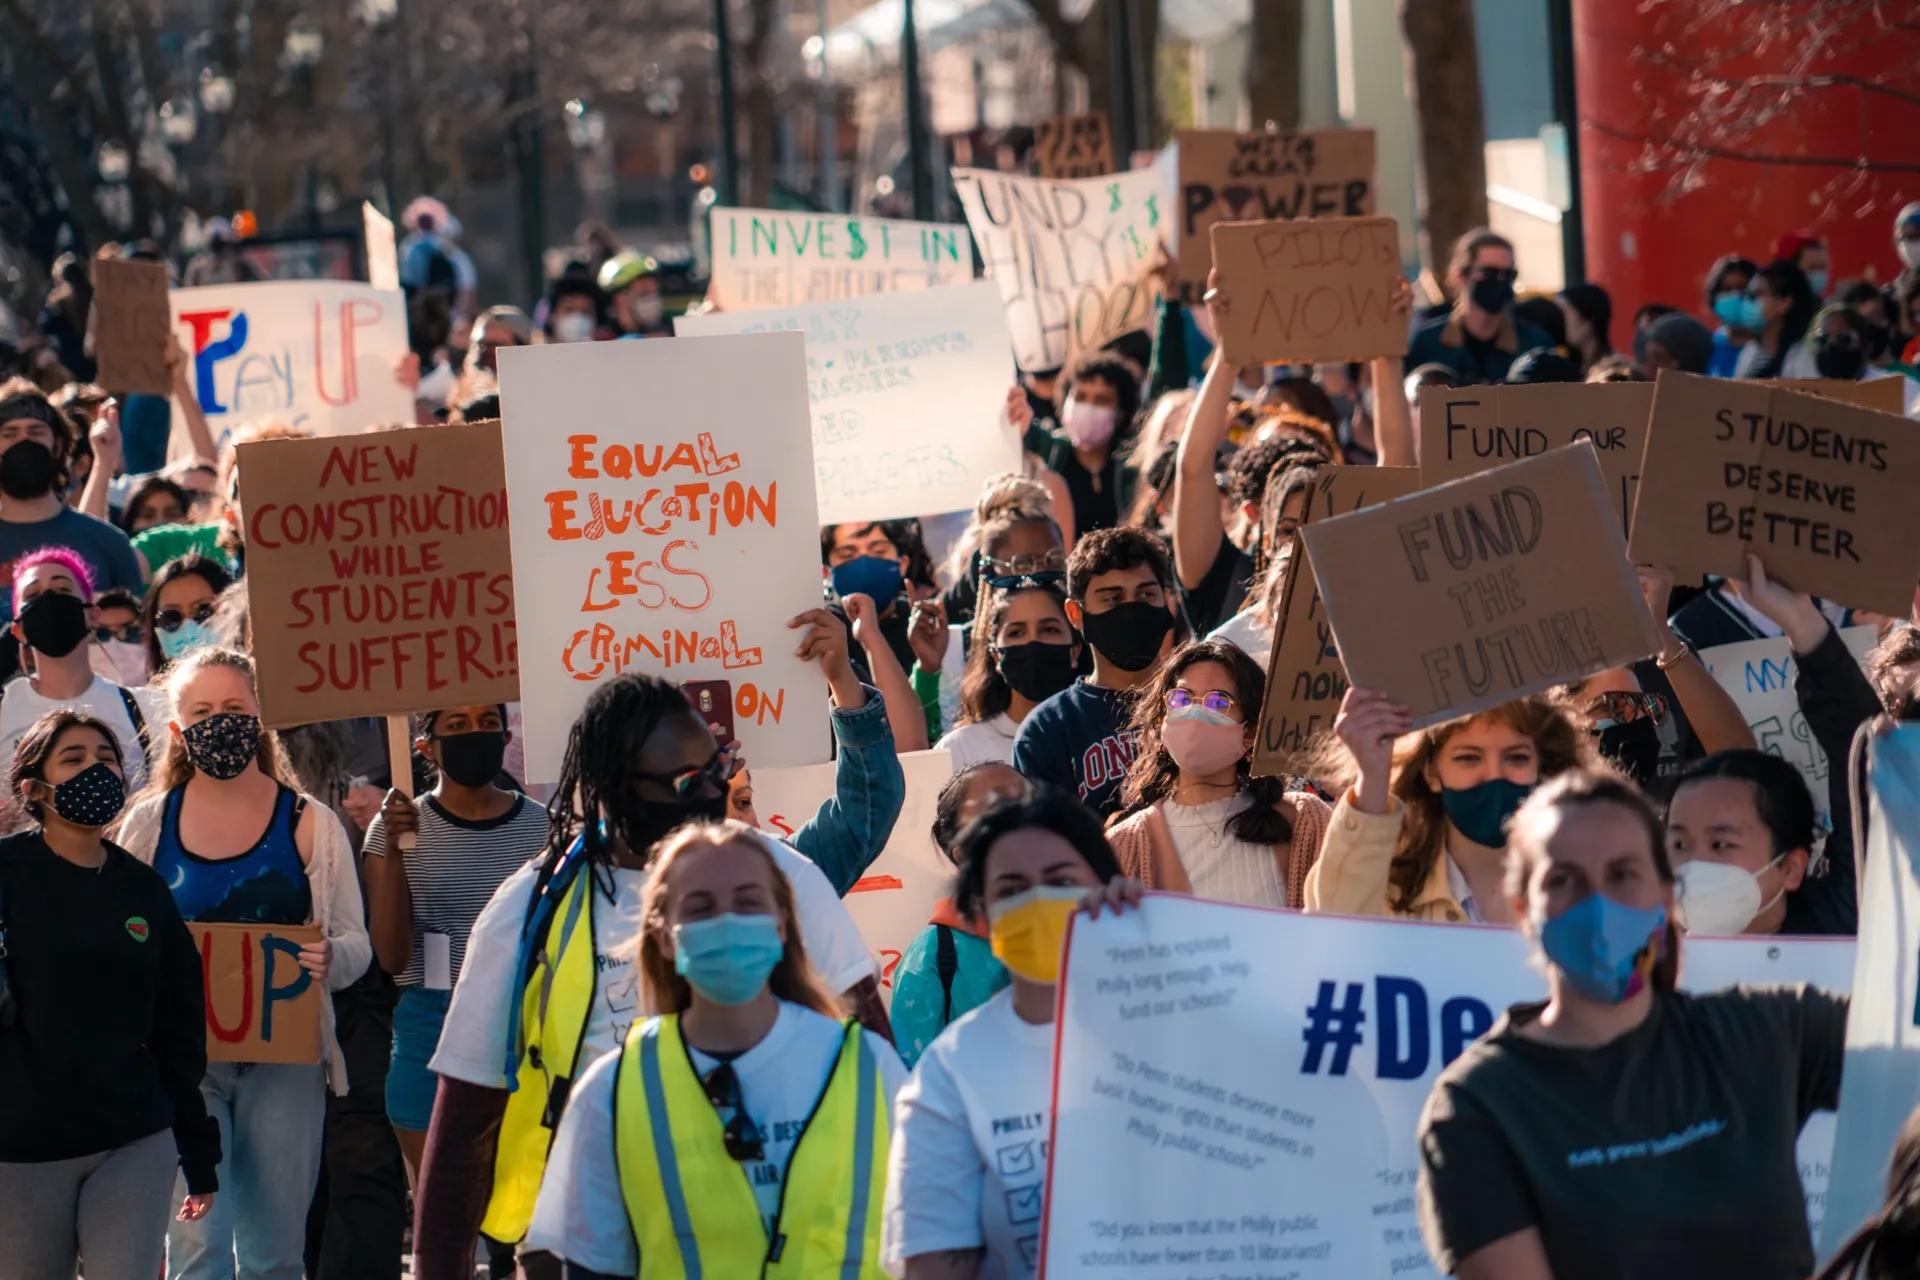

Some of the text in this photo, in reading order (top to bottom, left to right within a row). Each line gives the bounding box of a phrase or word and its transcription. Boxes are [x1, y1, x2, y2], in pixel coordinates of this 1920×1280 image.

[921, 229, 960, 263] IN
[1251, 284, 1393, 343] NOW
[312, 298, 384, 407] UP
[567, 432, 741, 481] EQUAL
[1446, 400, 1627, 461] FUND OUR
[1714, 409, 1889, 472] STUDENTS
[318, 443, 418, 488] NEW
[1724, 462, 1857, 513] DESERVE
[329, 541, 445, 579] WHILE
[1397, 485, 1543, 583] FUND
[1706, 501, 1861, 564] BETTER
[287, 571, 512, 629] STUDENTS
[580, 539, 714, 614] LESS
[1447, 564, 1527, 628] THE
[1420, 607, 1608, 711] FUTURE
[1745, 656, 1791, 694] MY
[202, 930, 313, 1043] UP
[1300, 974, 1495, 1081] #De
[992, 1112, 1044, 1135] PHILLY
[1128, 1088, 1174, 1114] human
[1176, 1105, 1211, 1130] rights
[1214, 1114, 1242, 1137] than
[1246, 1126, 1299, 1154] students
[1301, 1143, 1315, 1158] in
[1172, 1074, 1227, 1103] students
[1229, 1091, 1279, 1118] deserve
[1281, 1108, 1316, 1129] more
[1127, 1116, 1161, 1145] Philly
[1162, 1131, 1204, 1155] public
[1080, 1249, 1127, 1267] schools
[1131, 1248, 1161, 1266] have
[1165, 1246, 1201, 1264] fewer
[1205, 1245, 1235, 1263] than
[1240, 1243, 1256, 1261] 10
[1121, 1224, 1145, 1241] you
[1148, 1219, 1183, 1236] know
[1187, 1218, 1213, 1235] that
[1216, 1217, 1237, 1234] the
[1240, 1214, 1276, 1237] Philly
[1278, 1213, 1319, 1236] public
